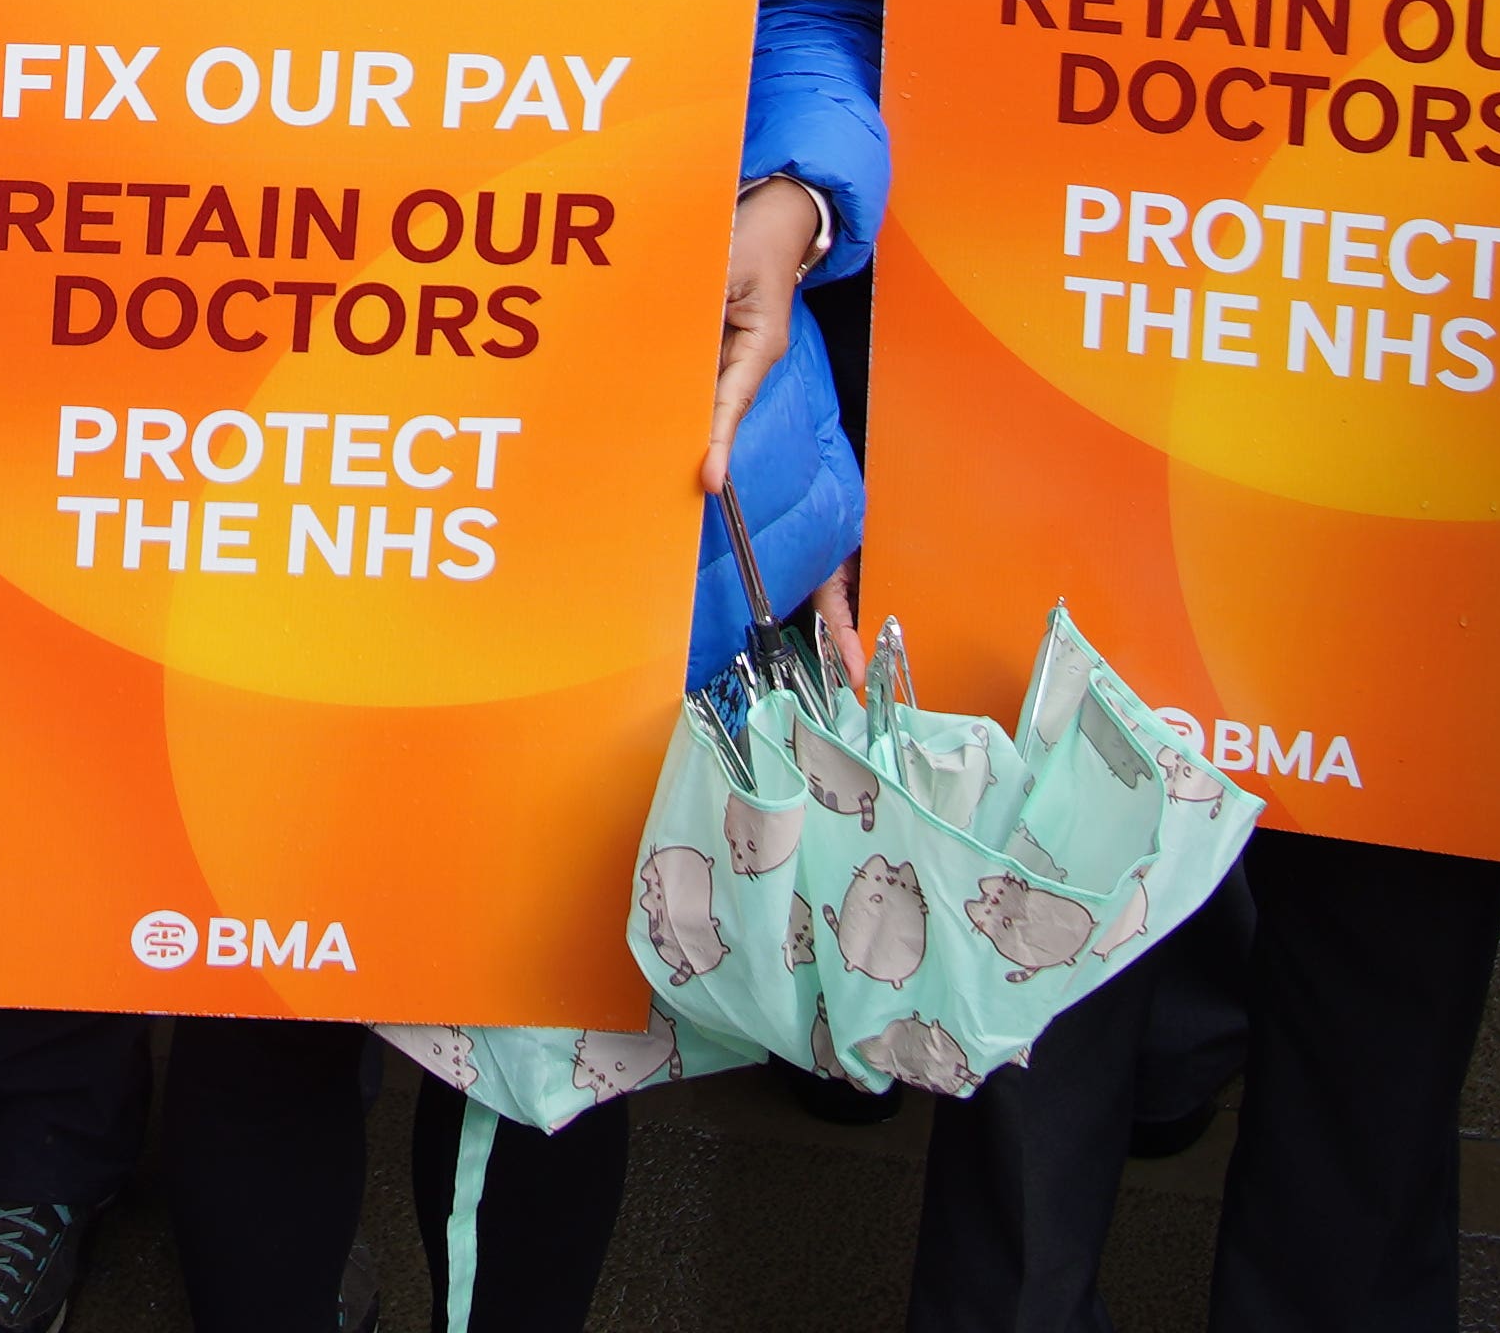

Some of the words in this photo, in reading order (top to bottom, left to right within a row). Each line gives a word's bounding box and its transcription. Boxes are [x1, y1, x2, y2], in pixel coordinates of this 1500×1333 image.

[2, 43, 161, 122] FIX
[185, 46, 415, 128] OUR
[442, 52, 632, 132] PAY
[391, 188, 615, 266] OUR
[51, 274, 542, 359] DOCTORS
[1064, 275, 1260, 368] THE
[1286, 300, 1497, 393] NHS
[56, 405, 522, 490] PROTECT
[56, 496, 259, 574] THE
[287, 504, 498, 582] NHS
[1211, 719, 1363, 790] BMA
[206, 917, 357, 972] BMA
